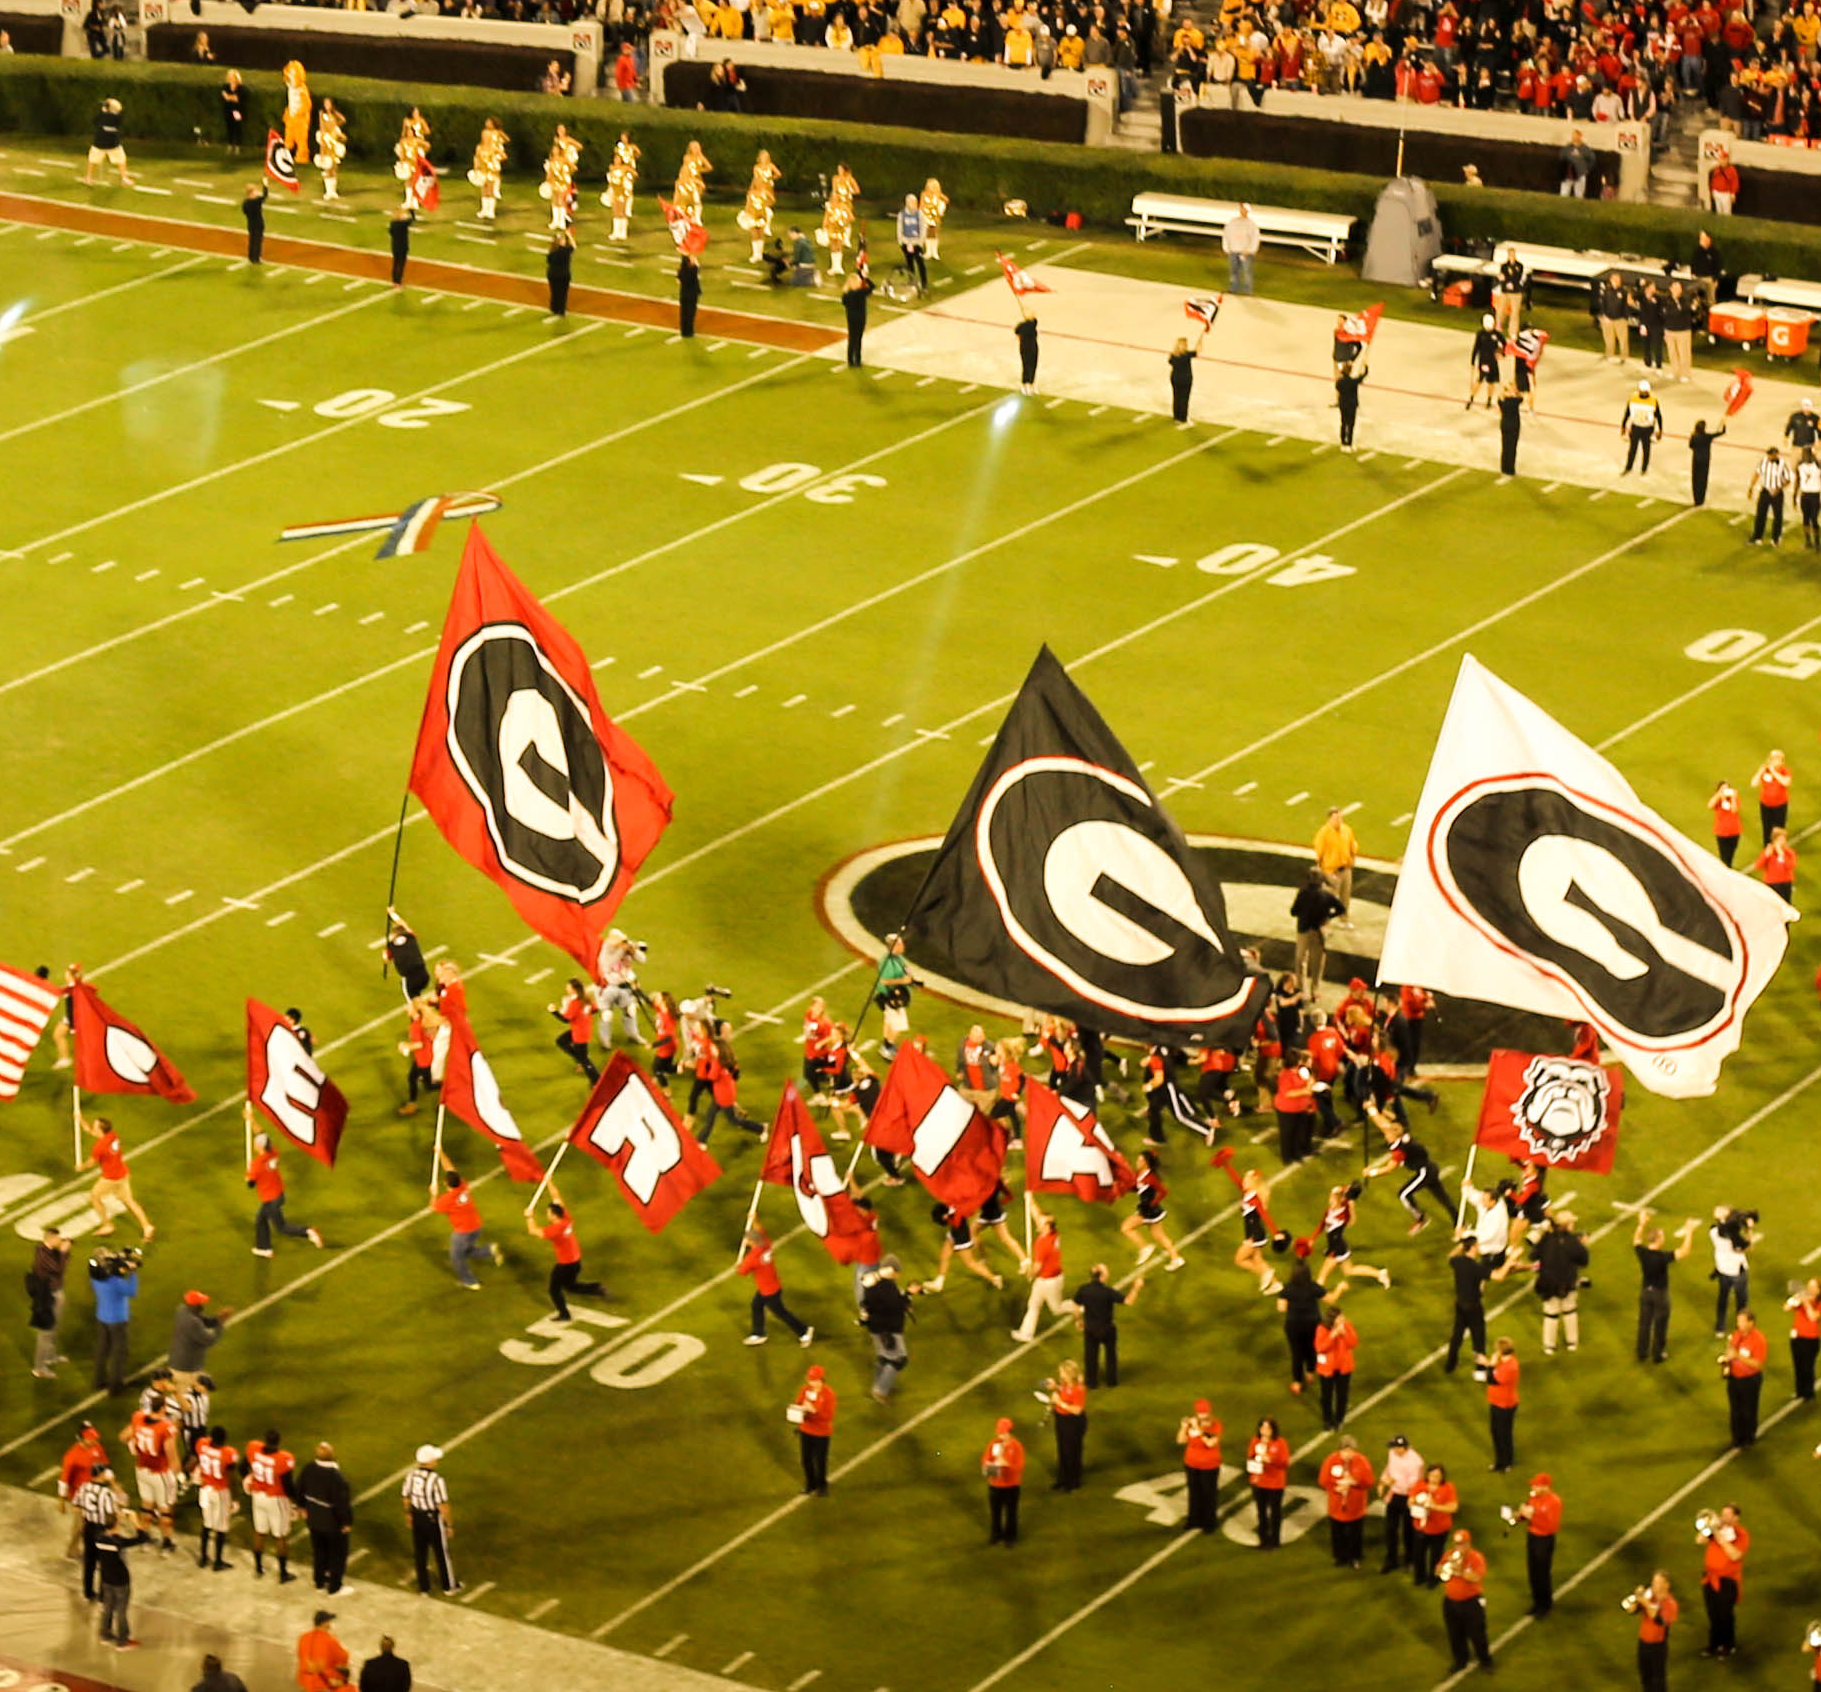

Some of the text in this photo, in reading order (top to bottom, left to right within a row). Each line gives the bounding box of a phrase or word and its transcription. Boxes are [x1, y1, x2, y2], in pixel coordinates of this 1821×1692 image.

[1772, 326, 1789, 346] G
[313, 388, 473, 429] 20
[738, 462, 889, 505] 30
[1196, 542, 1359, 589] 40
[590, 1073, 681, 1206] R
[498, 1304, 707, 1389] 50
